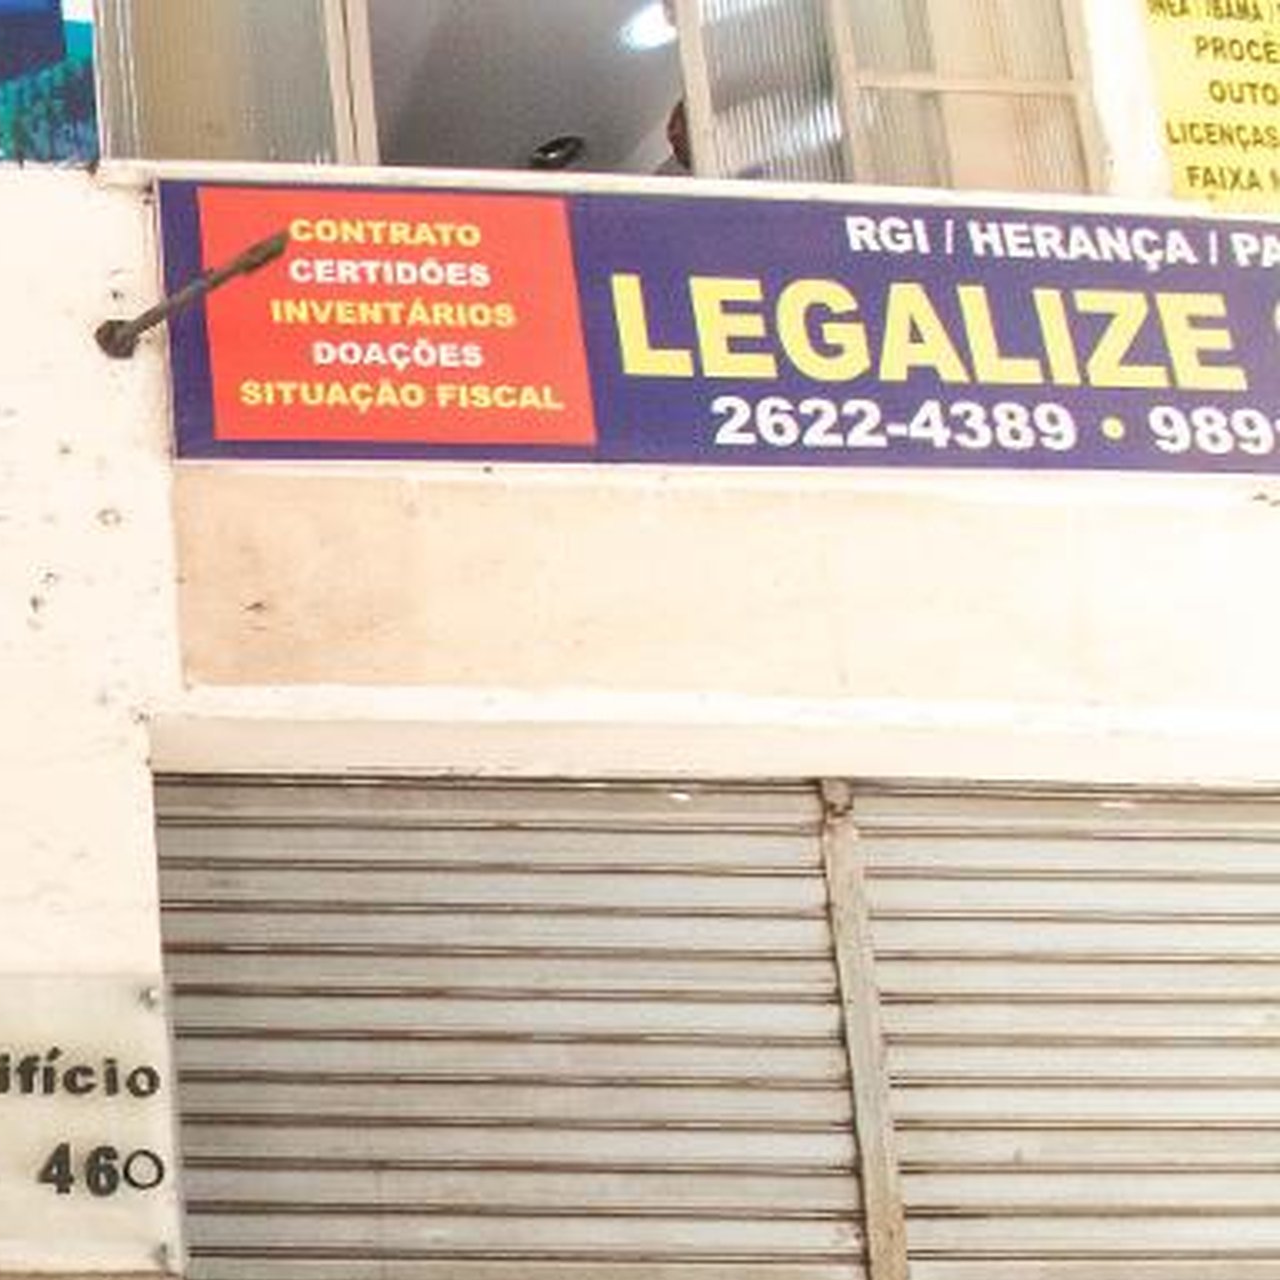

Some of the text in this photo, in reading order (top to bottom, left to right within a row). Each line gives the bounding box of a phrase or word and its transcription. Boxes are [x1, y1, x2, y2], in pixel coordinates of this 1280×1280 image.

[289, 218, 481, 248] CONTRATO
[845, 216, 931, 254] RGI
[968, 220, 1198, 272] HERANÇA
[289, 256, 491, 288] CERTIDÕES
[269, 298, 516, 328] INVENTÁRIOS
[610, 273, 1248, 392] LEGALIZE
[312, 338, 484, 370] DOAÇÕES
[240, 378, 565, 413] SITUAÇÃO FISCAL
[711, 396, 1280, 455] 2622-4389 989
[37, 1142, 165, 1196] 460
